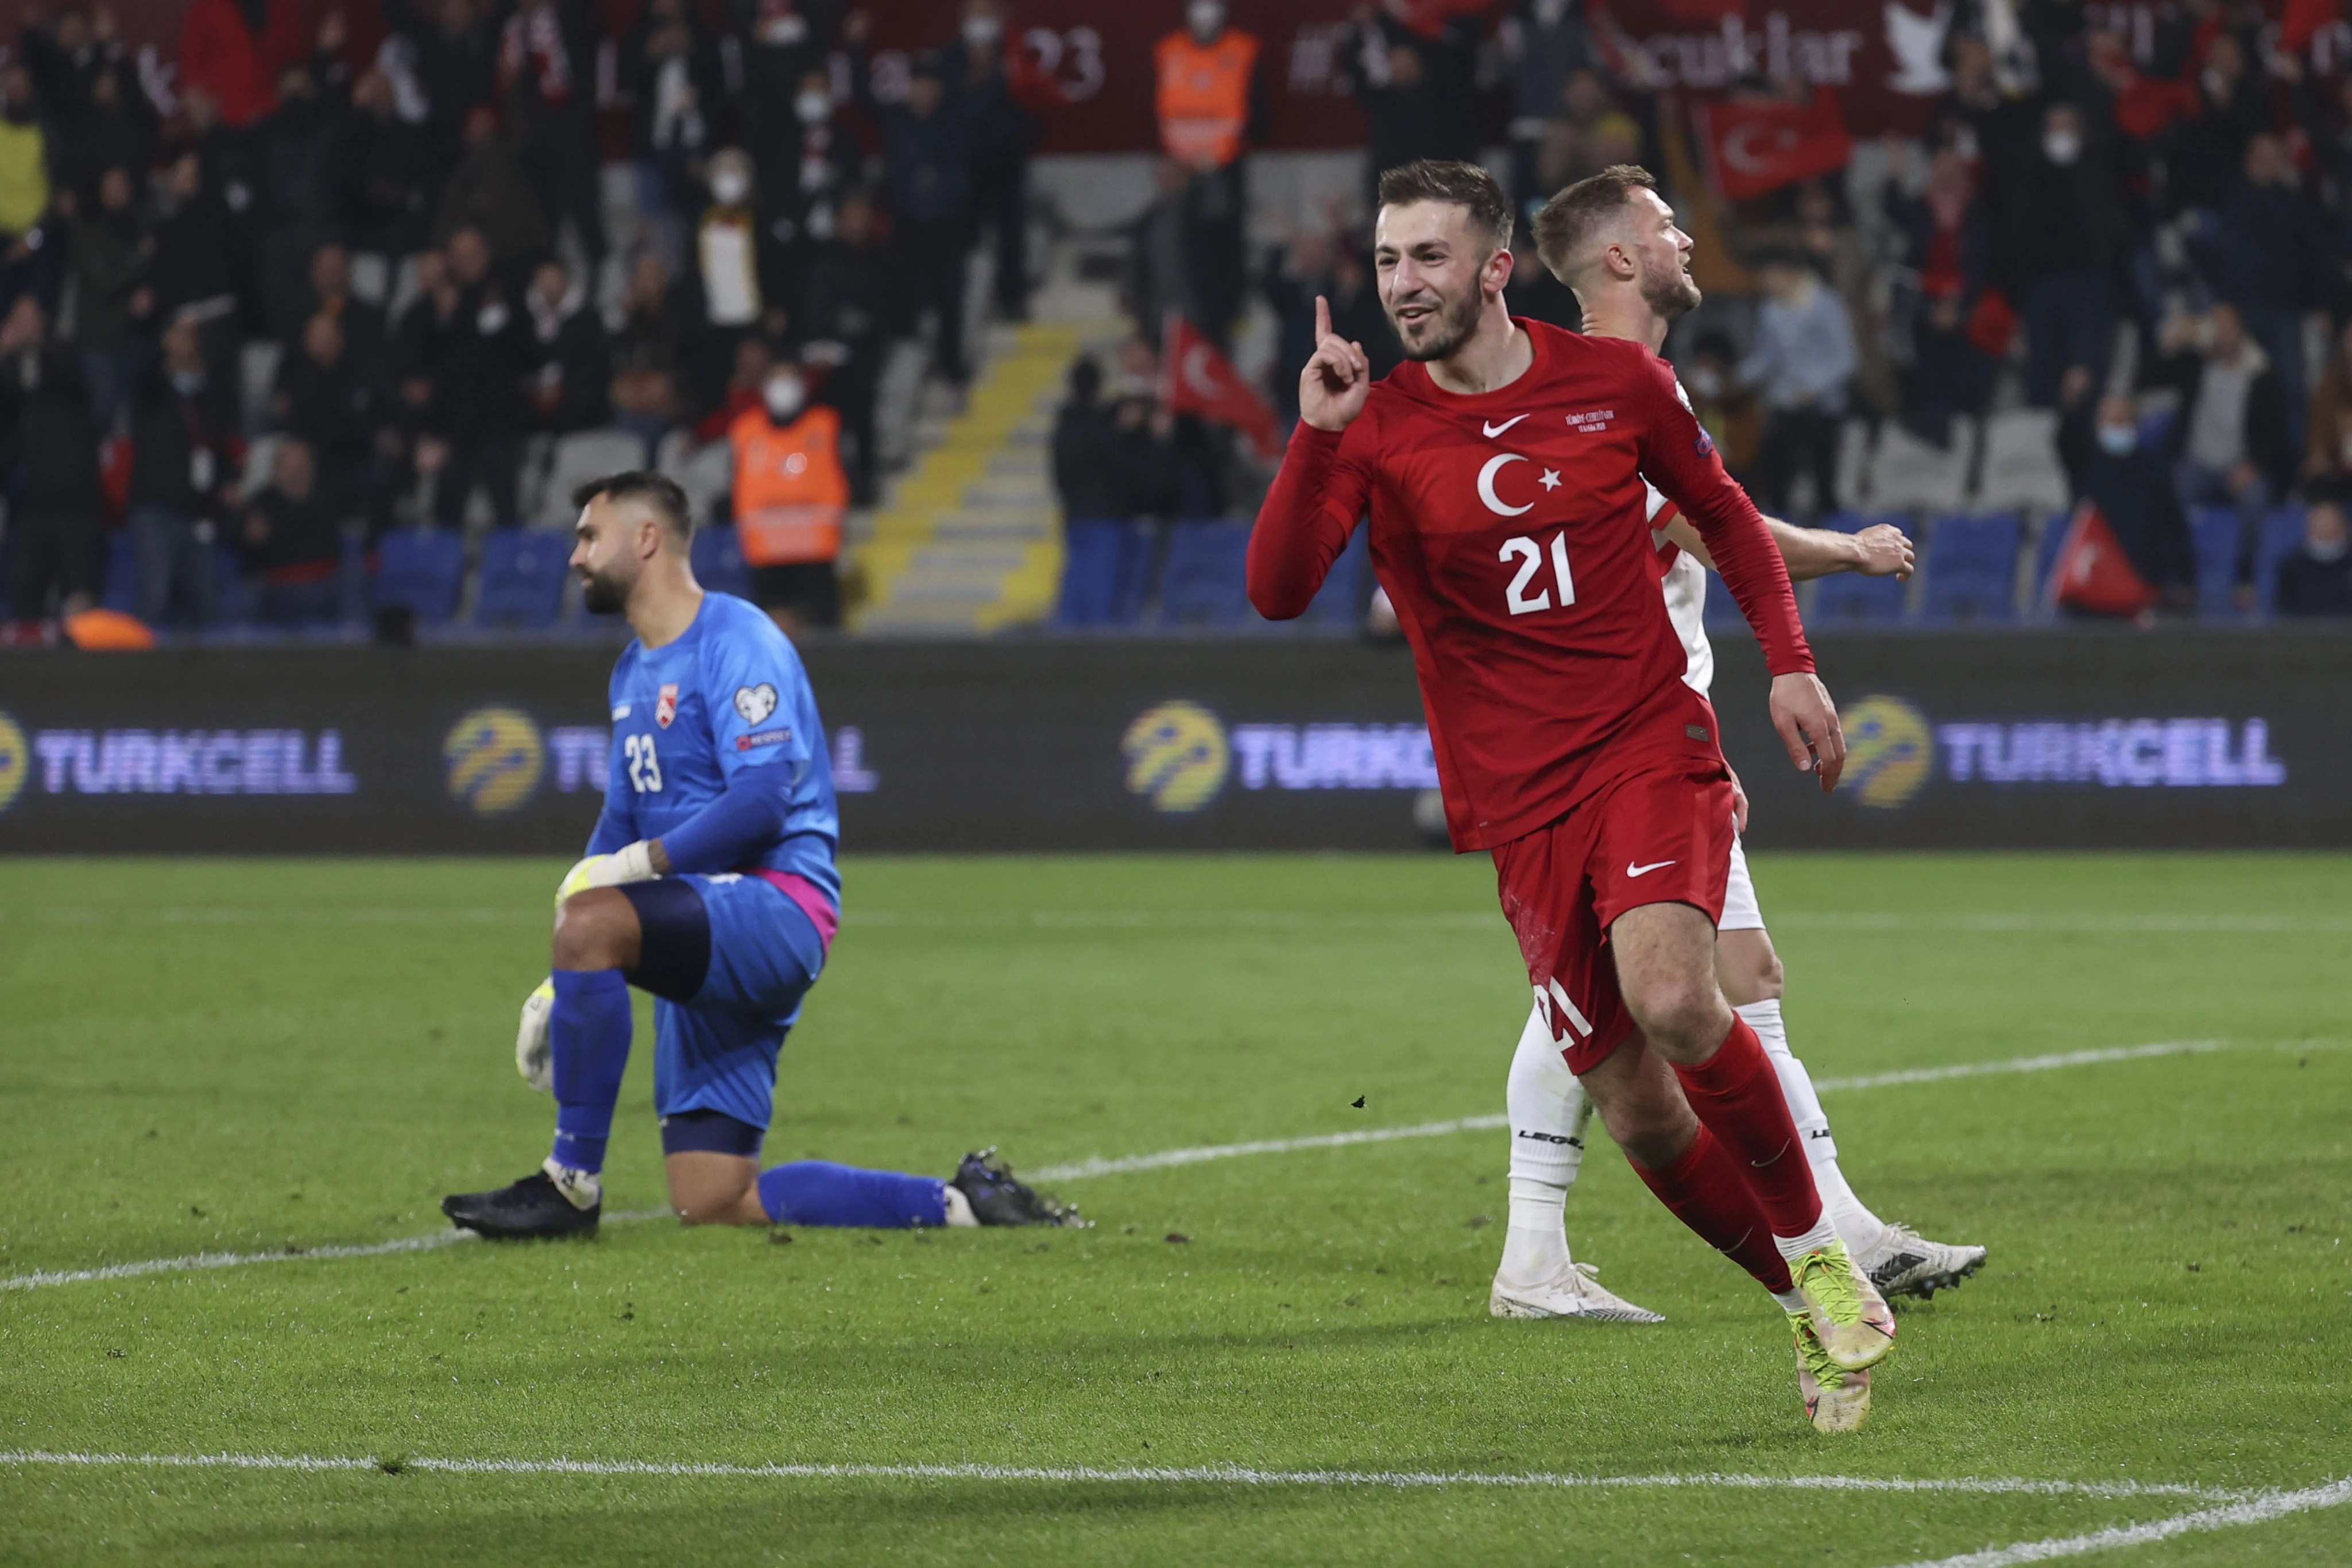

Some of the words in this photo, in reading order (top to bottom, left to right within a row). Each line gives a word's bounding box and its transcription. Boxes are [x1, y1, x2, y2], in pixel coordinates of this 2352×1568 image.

[1498, 530, 1576, 615] 21
[34, 728, 359, 794] TURKCELL
[625, 733, 662, 793] 23
[1230, 723, 1440, 789] TURKC
[1936, 717, 2288, 786] TURKCELL
